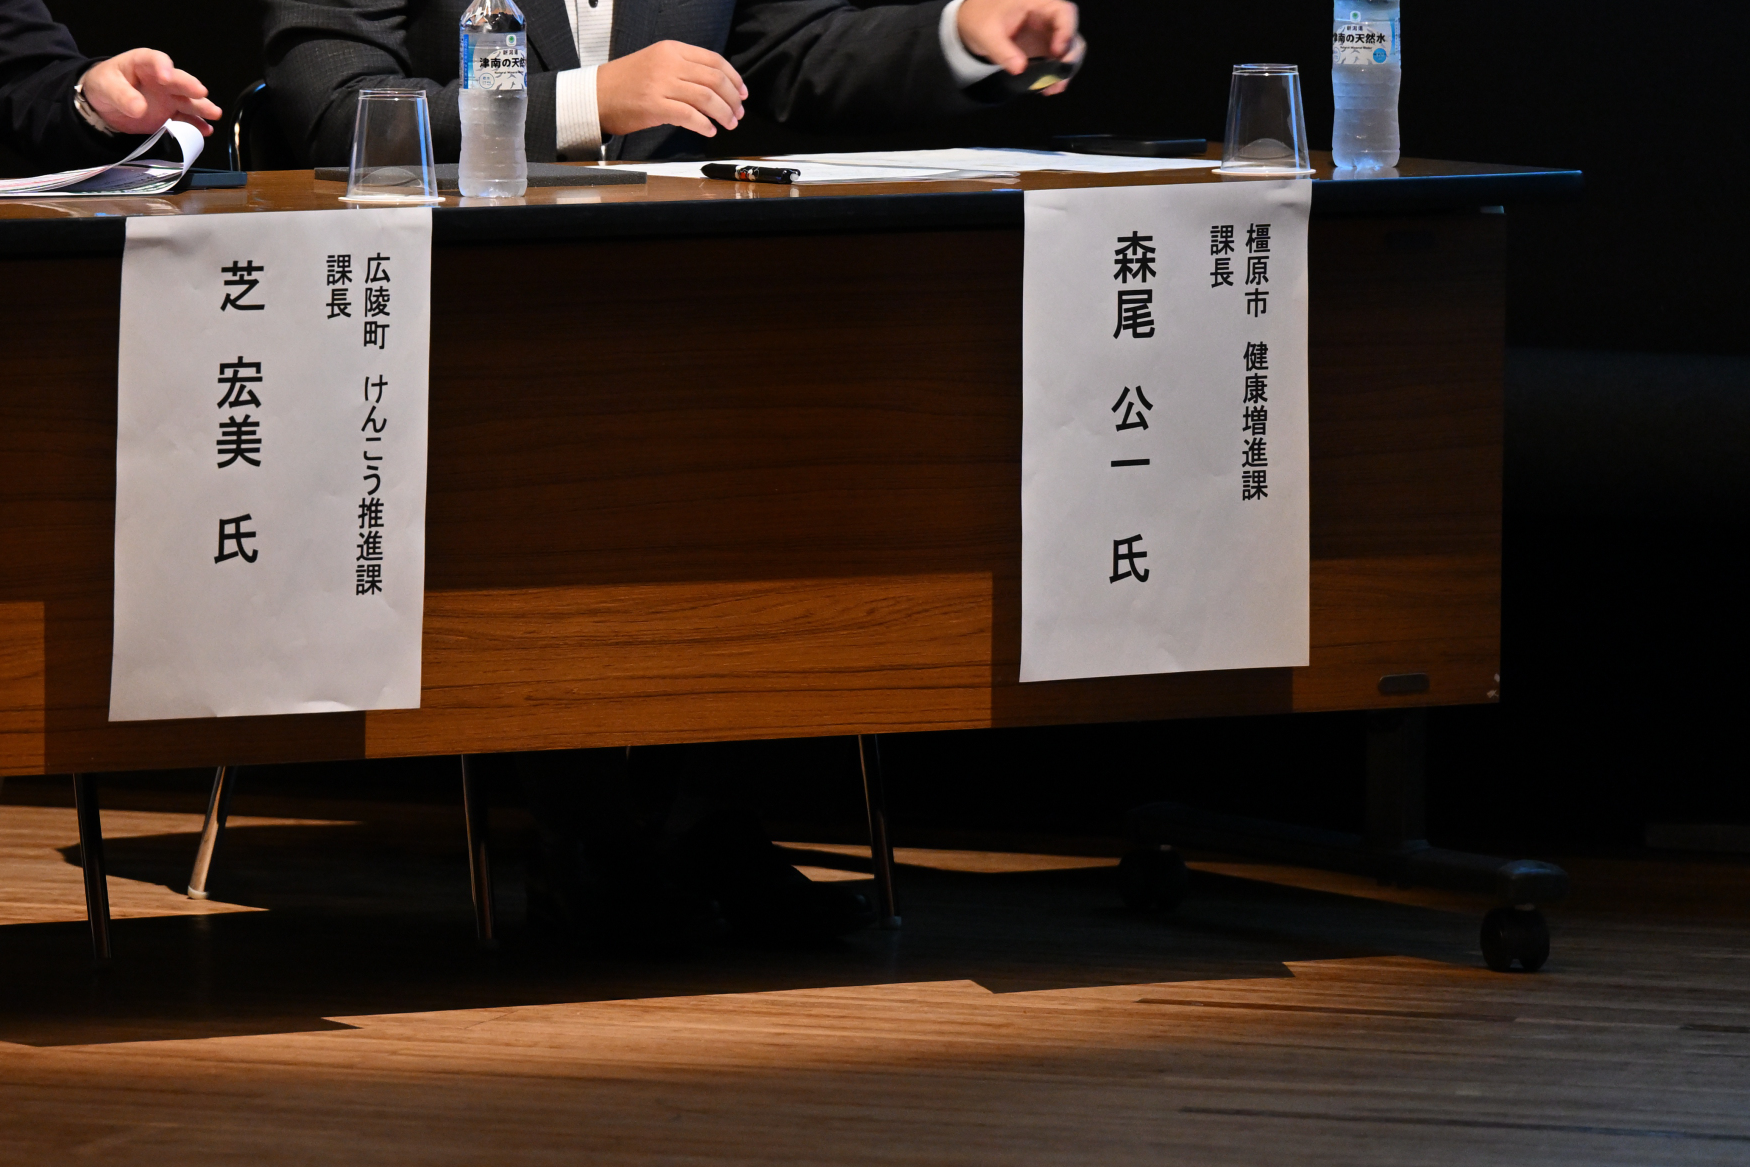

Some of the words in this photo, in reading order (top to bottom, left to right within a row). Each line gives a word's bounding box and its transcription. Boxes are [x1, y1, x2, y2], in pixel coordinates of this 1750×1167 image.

[219, 259, 265, 312] 芝
[325, 253, 353, 320] 課長
[1113, 230, 1157, 340] 森尾
[1209, 225, 1235, 288] 課長
[1244, 223, 1271, 318] 橿原市
[363, 252, 391, 350] 広陵町
[216, 355, 263, 469] 宏美
[1110, 385, 1153, 467] 公一
[1241, 341, 1269, 501] 健康増進課
[355, 374, 388, 596] けんこう推進課
[213, 513, 259, 564] 氏
[1109, 534, 1150, 584] 氏
